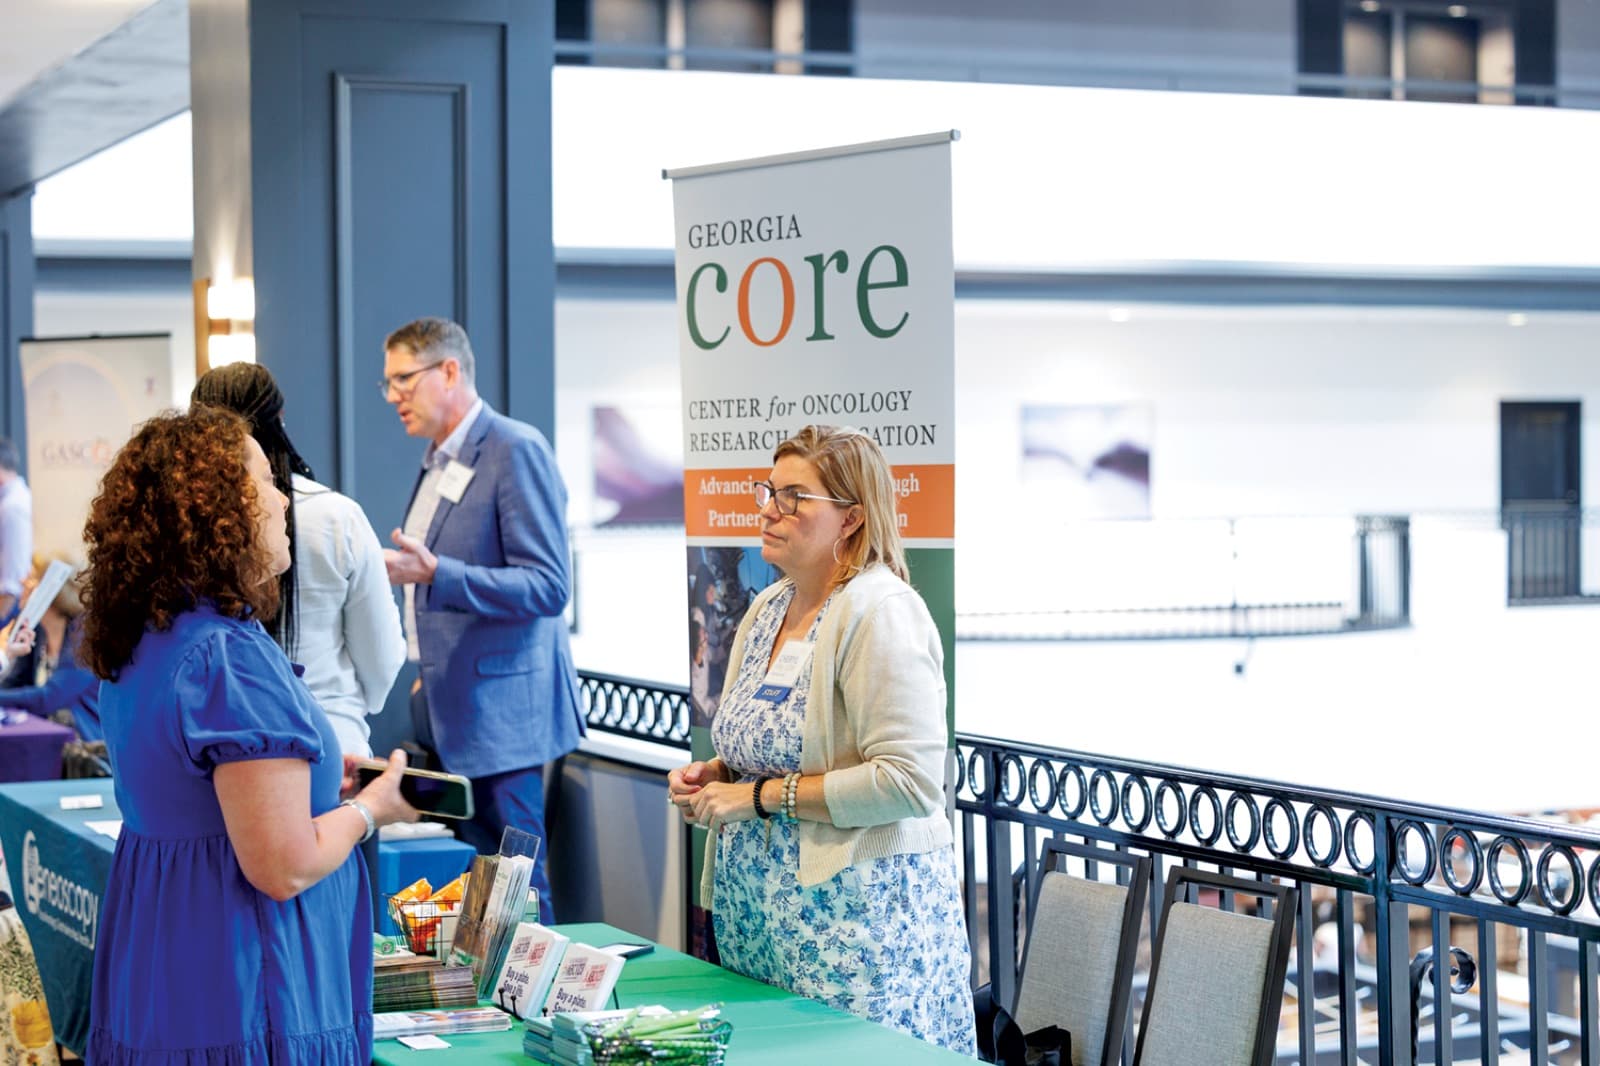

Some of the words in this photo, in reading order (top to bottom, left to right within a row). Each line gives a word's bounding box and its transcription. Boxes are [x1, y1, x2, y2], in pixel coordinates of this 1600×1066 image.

[688, 213, 802, 249] GEORGIA
[686, 244, 909, 350] core
[689, 397, 762, 420] CENTER
[766, 395, 797, 422] for
[802, 391, 913, 416] ONCOLOGY
[690, 430, 789, 452] RESEARCH
[699, 474, 755, 495] Advanci
[708, 509, 761, 528] Partner
